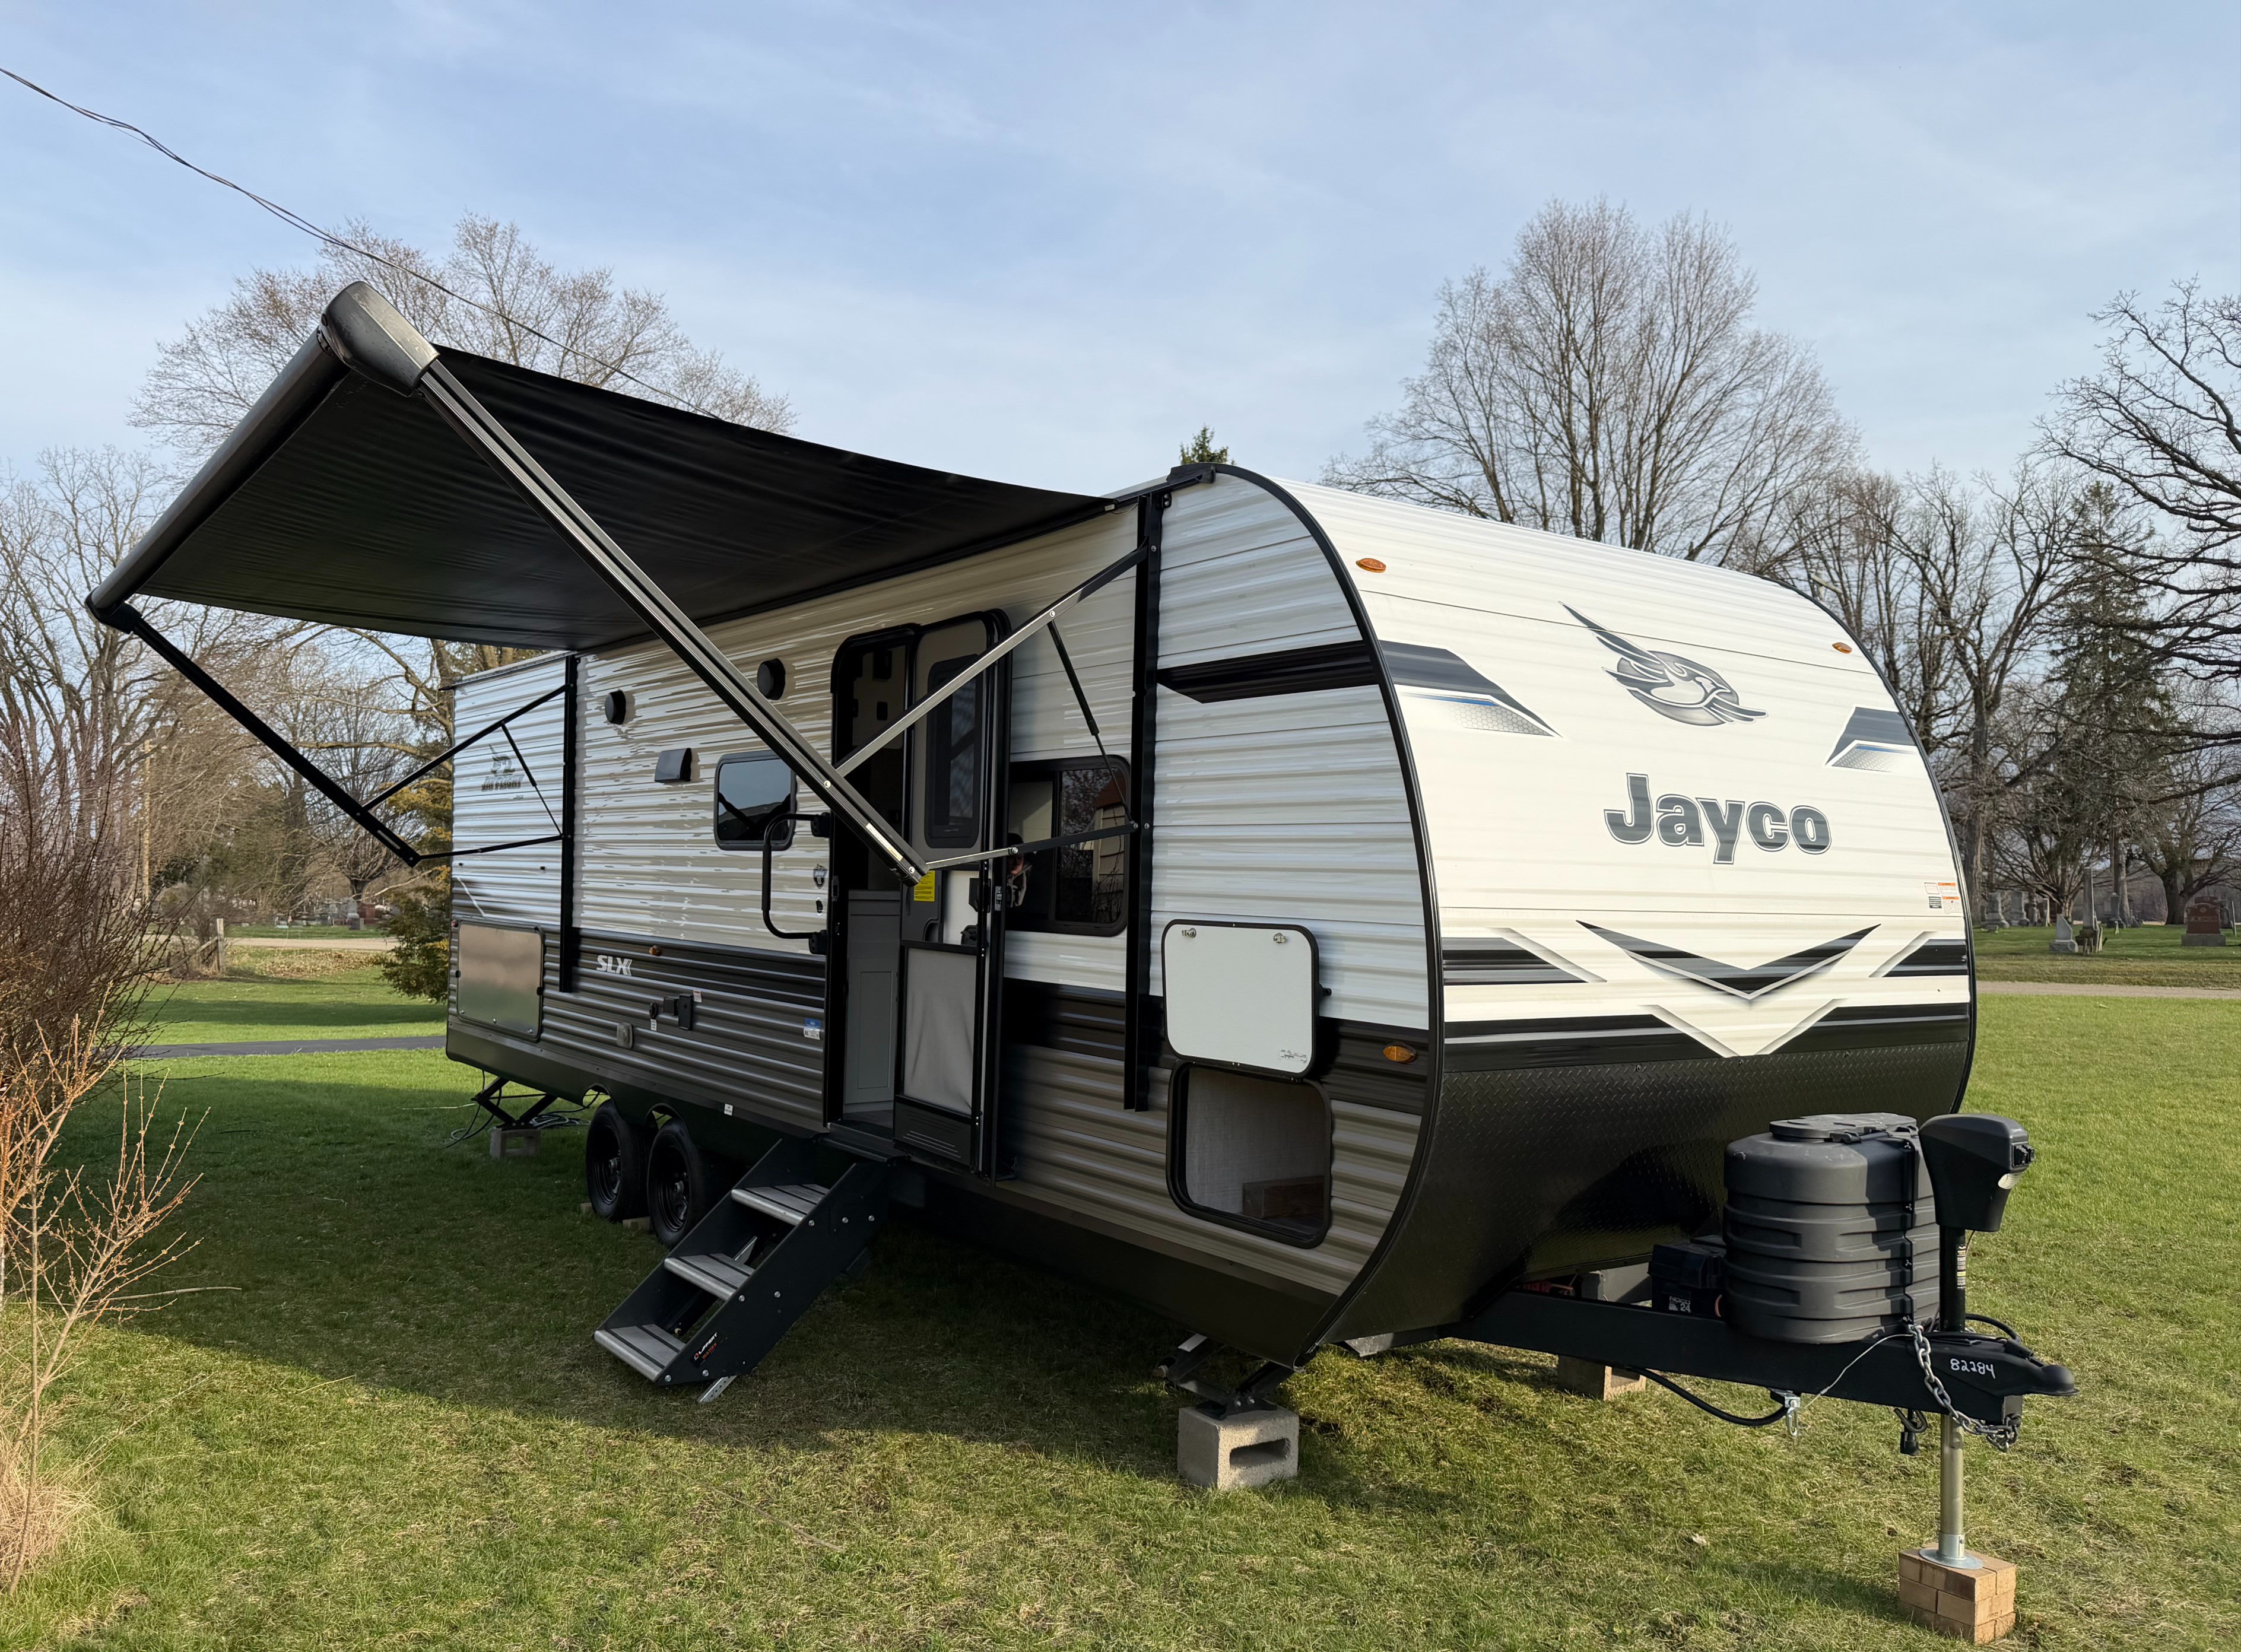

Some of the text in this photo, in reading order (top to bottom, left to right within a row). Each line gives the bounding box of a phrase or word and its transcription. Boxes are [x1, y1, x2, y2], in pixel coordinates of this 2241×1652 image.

[1604, 772, 1831, 865] Jayco
[596, 955, 633, 976] SLX
[1680, 1303, 1691, 1313] 24
[1950, 1358, 1996, 1380] 82284
